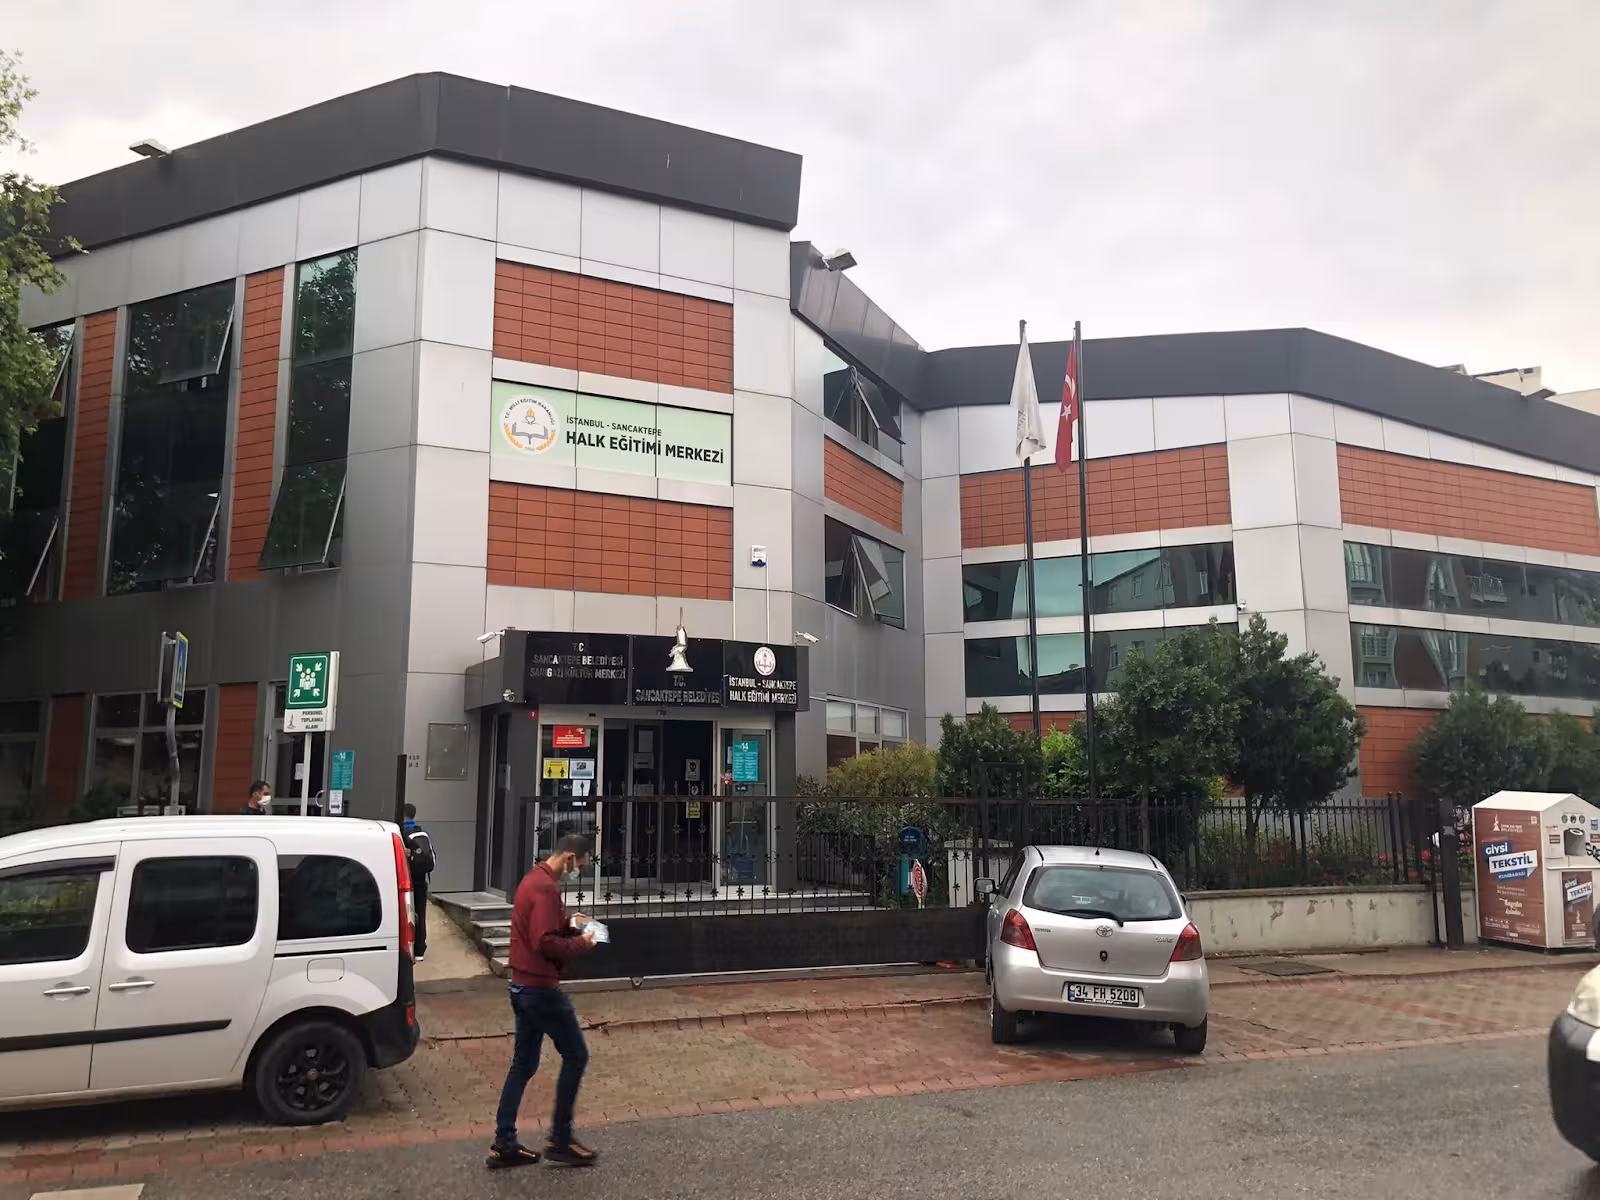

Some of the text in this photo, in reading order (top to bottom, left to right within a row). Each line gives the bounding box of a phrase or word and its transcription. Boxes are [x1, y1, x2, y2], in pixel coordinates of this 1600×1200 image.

[566, 415, 604, 428] İSTANBUL
[611, 422, 662, 436] SANCAKTEPE
[566, 431, 724, 464] HALK EĞİTİMİ MERKEZİ
[533, 654, 624, 666] SANCAKTEPE BELEDİYESİ
[594, 668, 626, 679] MERKEZİ
[729, 675, 757, 688] İSTANBUL
[635, 688, 682, 702] SANCAKTEPE
[729, 690, 797, 705] HALK EĞİTİMİ MERKEZİ
[1485, 842, 1508, 855] GİYSİ
[1491, 853, 1533, 869] TEKSTİL
[1570, 884, 1592, 897] TEKSTİL
[1076, 985, 1088, 997] 34
[1093, 987, 1106, 999] FH
[1110, 988, 1136, 1001] 5208
